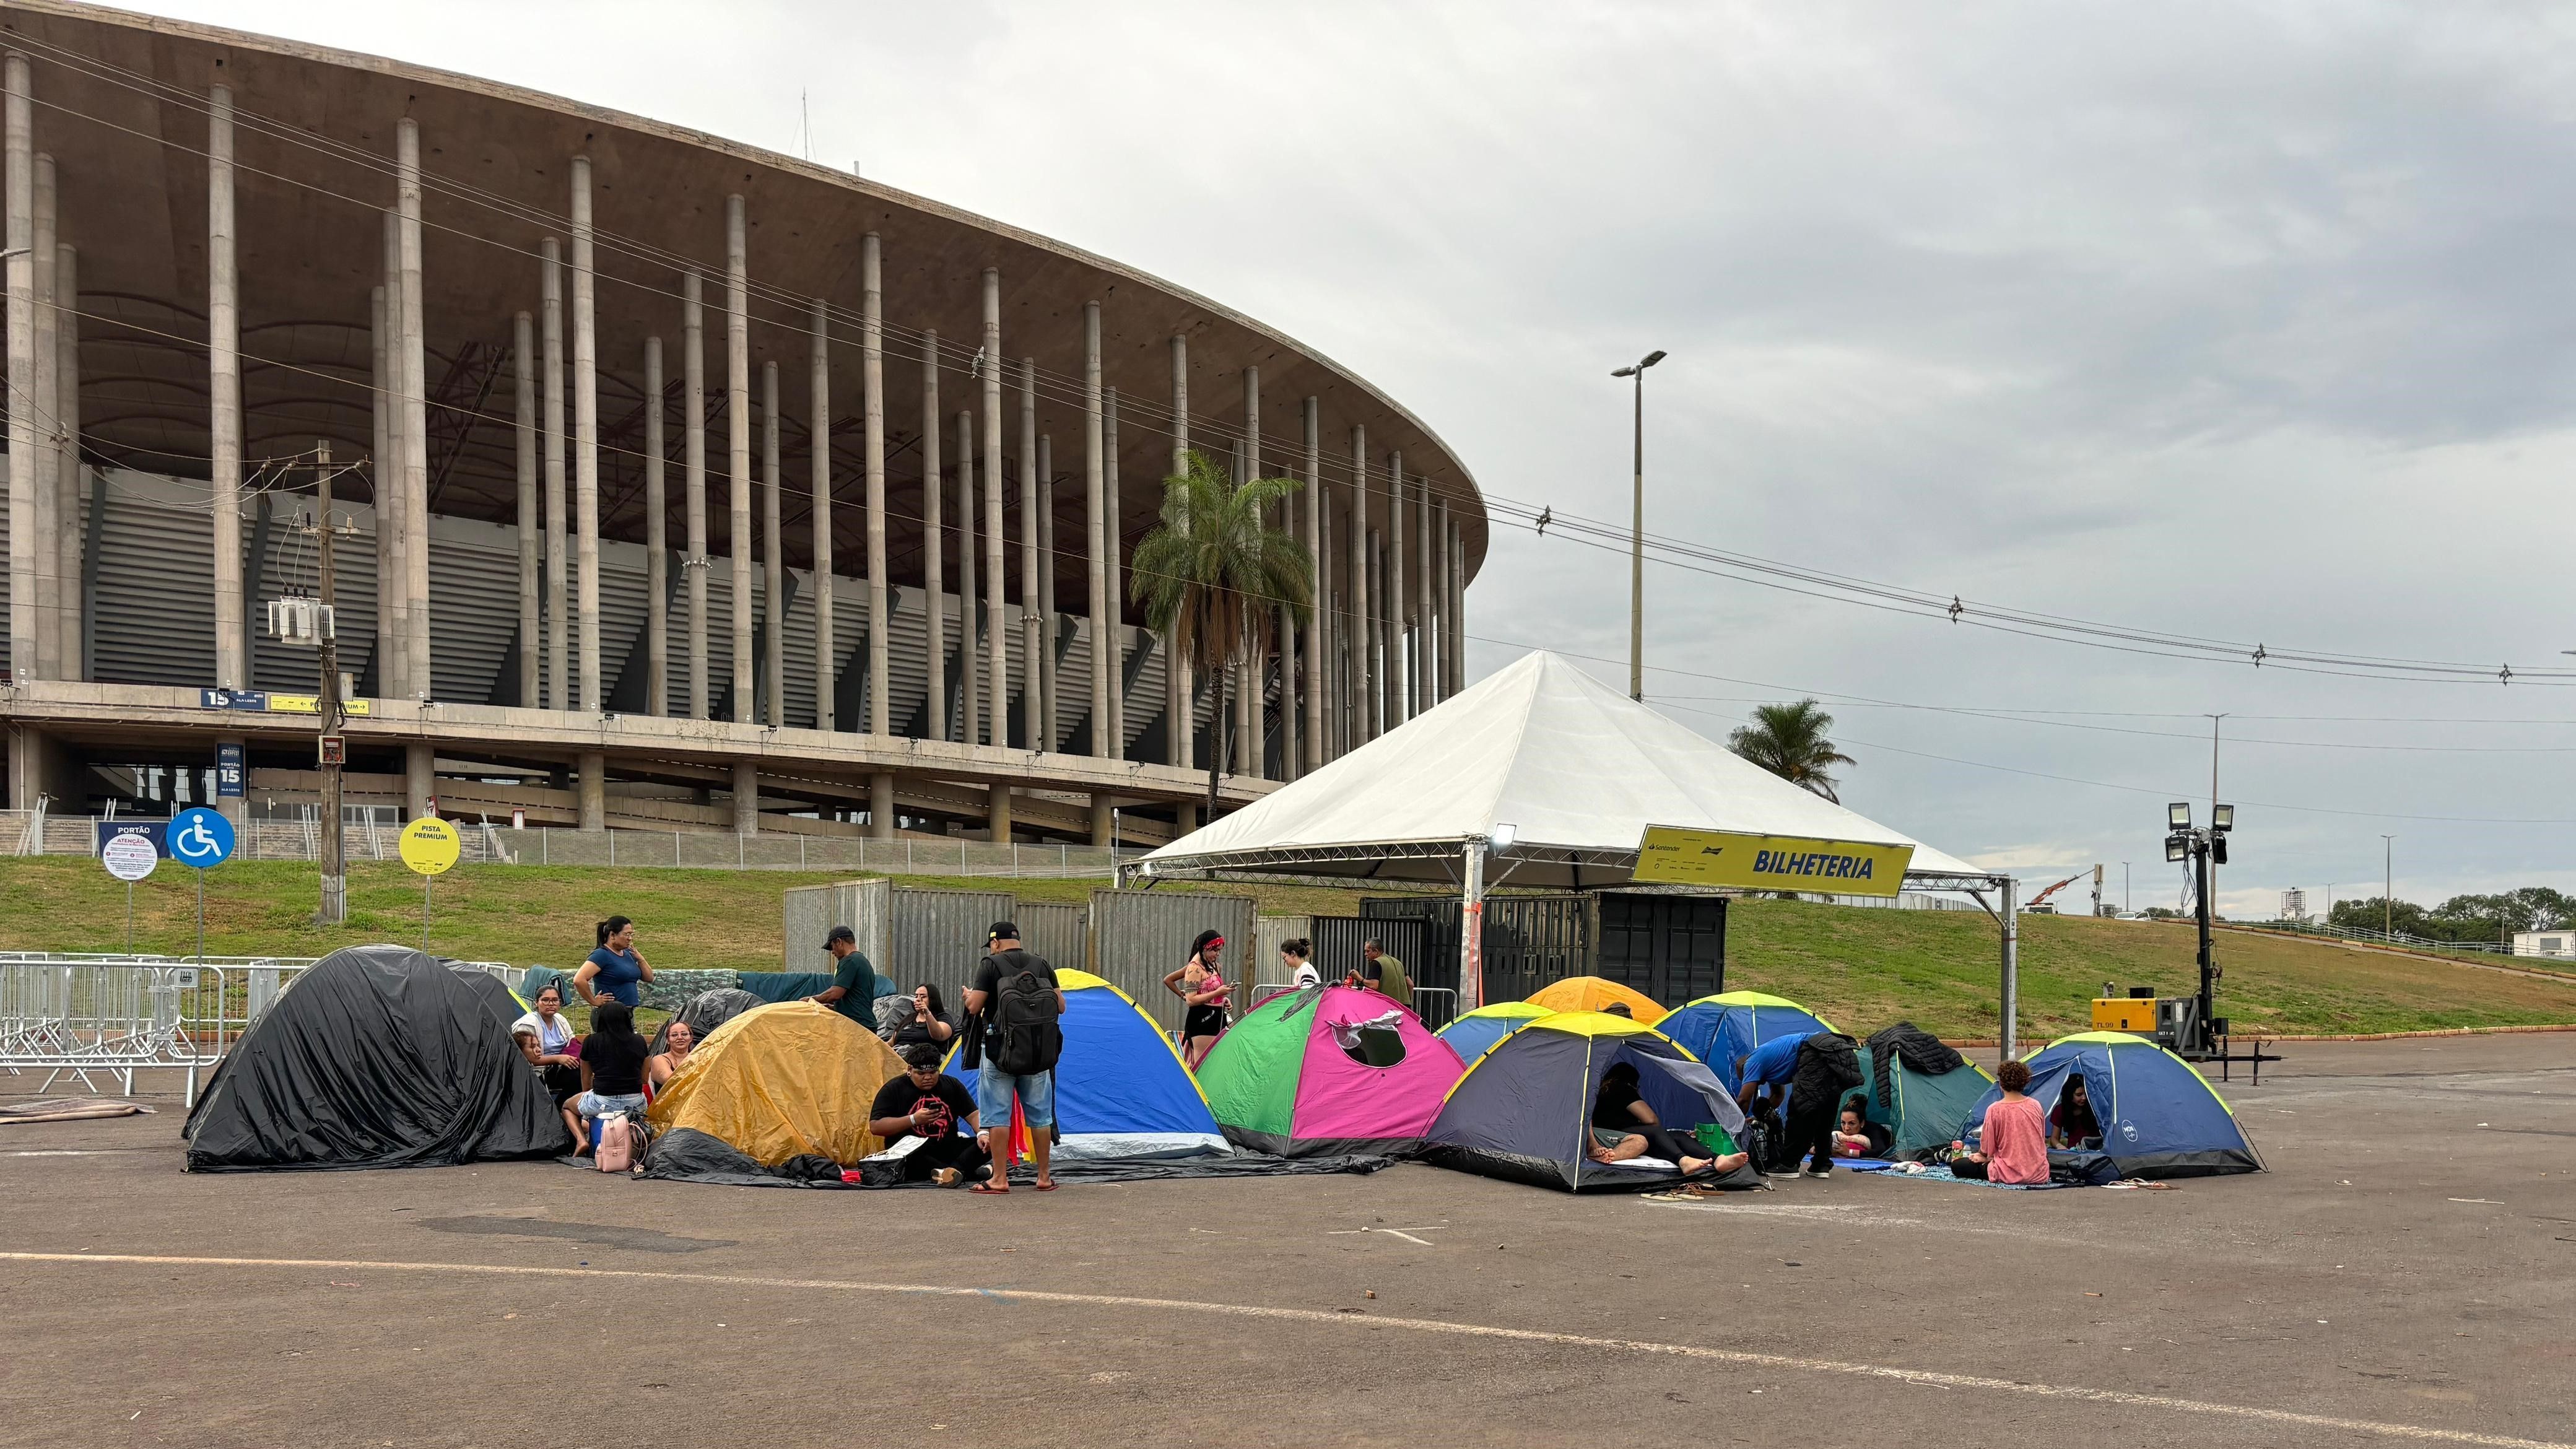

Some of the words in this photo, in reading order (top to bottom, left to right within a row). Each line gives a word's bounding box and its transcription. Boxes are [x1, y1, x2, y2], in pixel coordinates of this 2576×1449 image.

[208, 692, 229, 705] 15
[220, 769, 240, 783] 15
[1753, 850, 1873, 879] BILHETERIA
